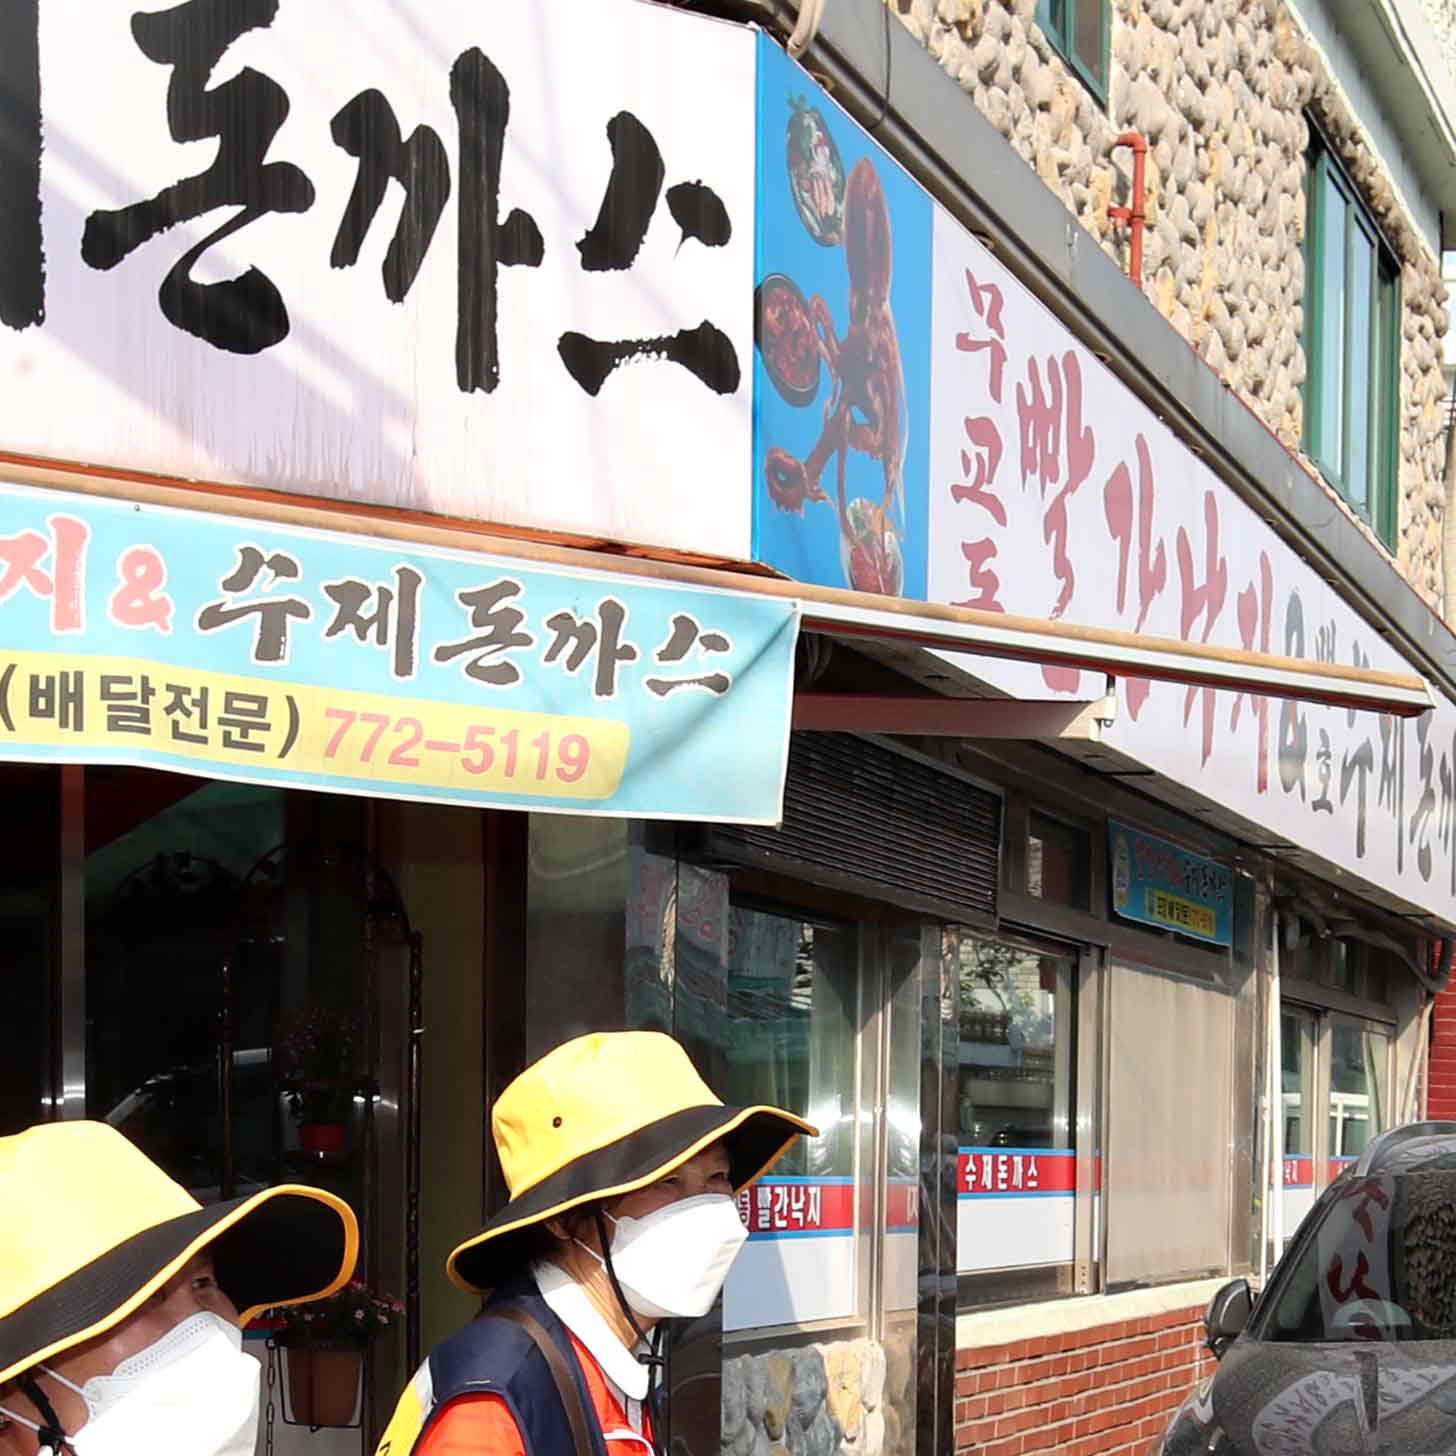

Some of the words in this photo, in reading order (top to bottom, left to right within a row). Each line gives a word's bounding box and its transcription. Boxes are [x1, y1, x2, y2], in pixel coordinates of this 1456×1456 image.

[198, 546, 732, 697] 수제돈까스
[323, 706, 592, 783] 772-5119
[964, 1153, 1040, 1192] 수제돈까스
[757, 1186, 821, 1229] 빨간낙지
